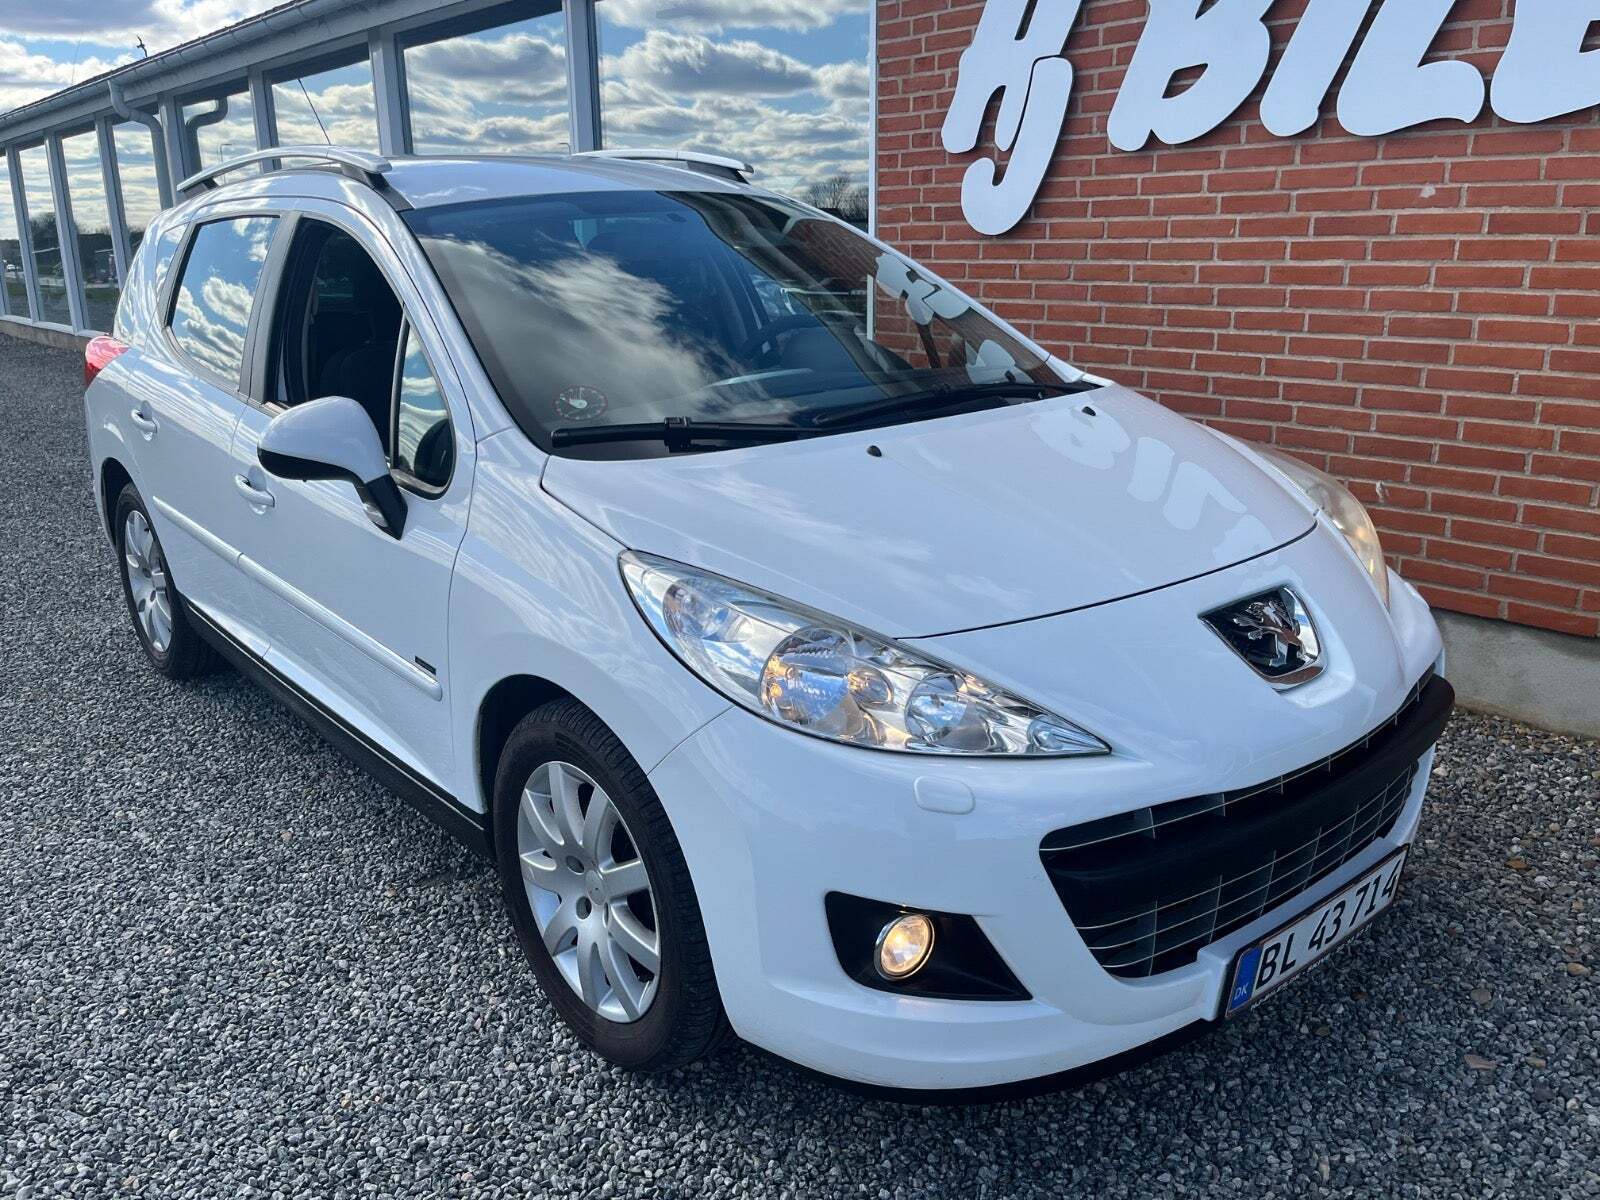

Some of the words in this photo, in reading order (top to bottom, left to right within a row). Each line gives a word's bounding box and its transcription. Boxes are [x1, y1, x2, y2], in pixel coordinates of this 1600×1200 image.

[1256, 933, 1296, 990] BL
[1308, 900, 1346, 950] 43
[1350, 860, 1401, 927] 714
[1234, 982, 1249, 1000] DK
